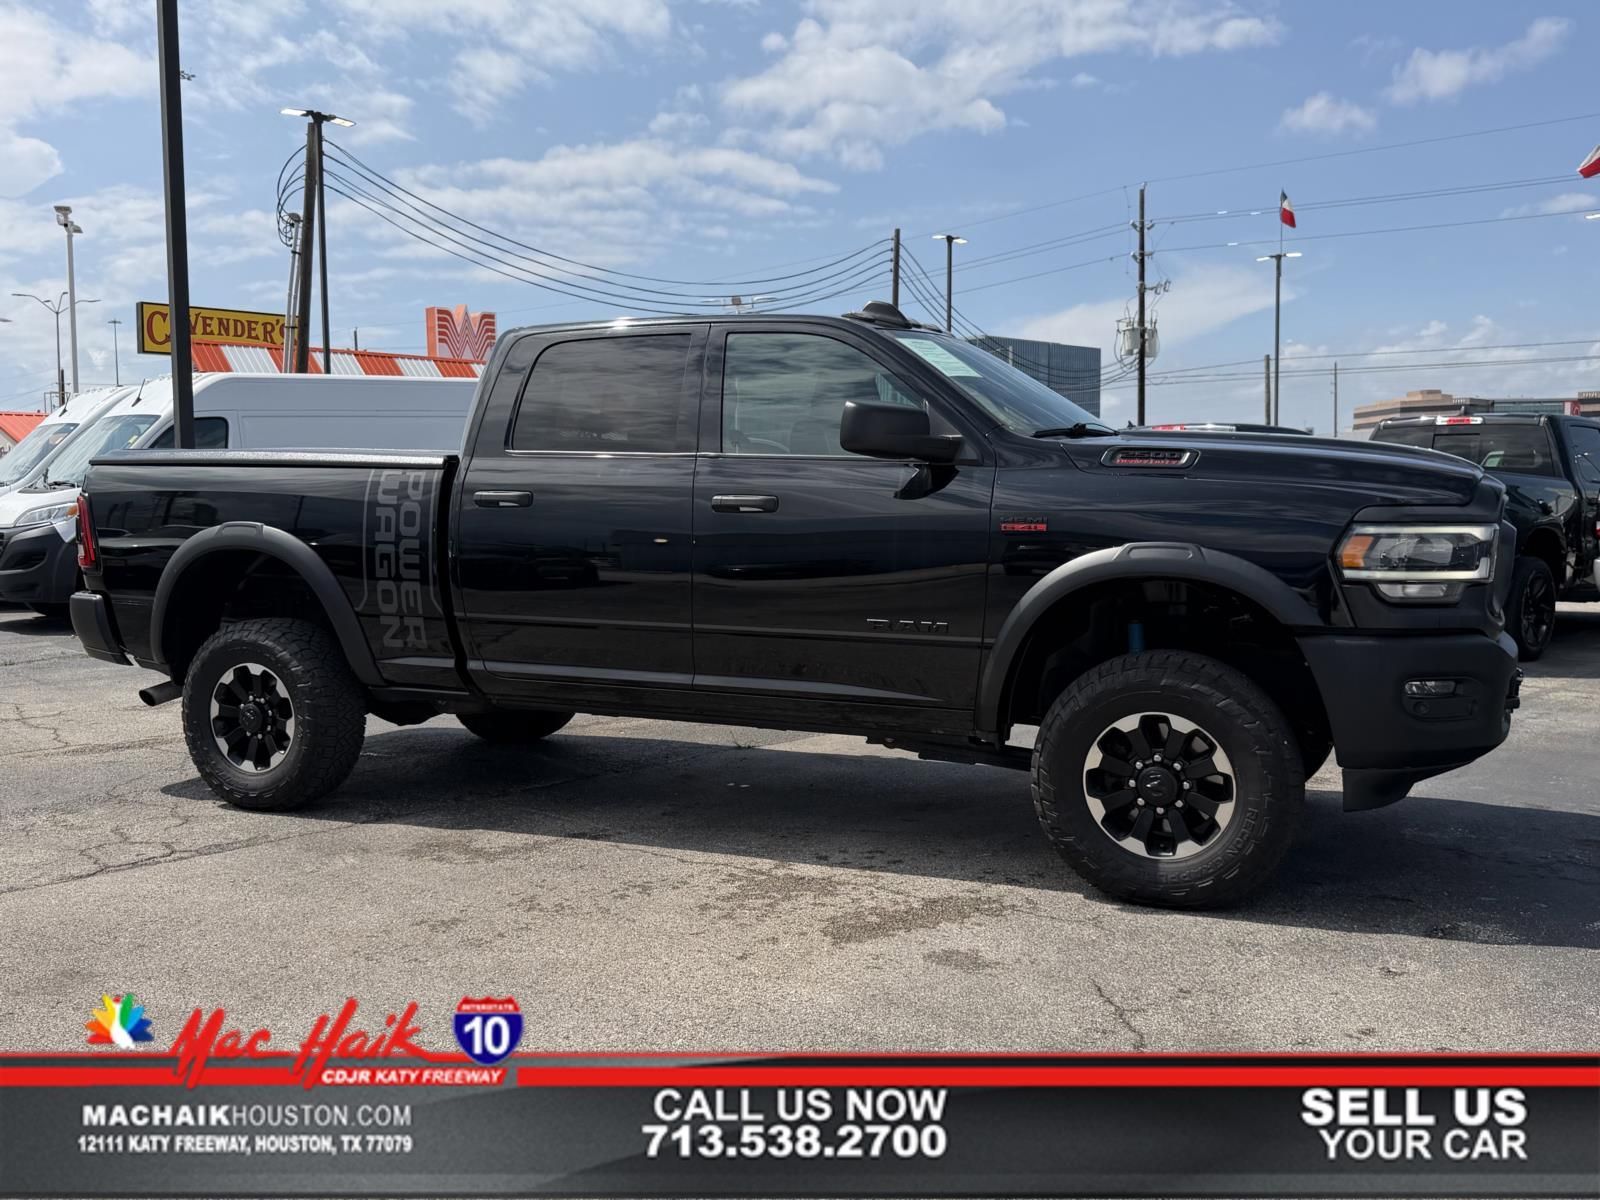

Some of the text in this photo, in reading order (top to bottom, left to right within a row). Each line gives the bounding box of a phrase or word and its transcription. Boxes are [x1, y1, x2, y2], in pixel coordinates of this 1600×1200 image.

[146, 310, 299, 346] CVENDER'
[374, 470, 404, 648] WAGON
[399, 471, 428, 649] POWER
